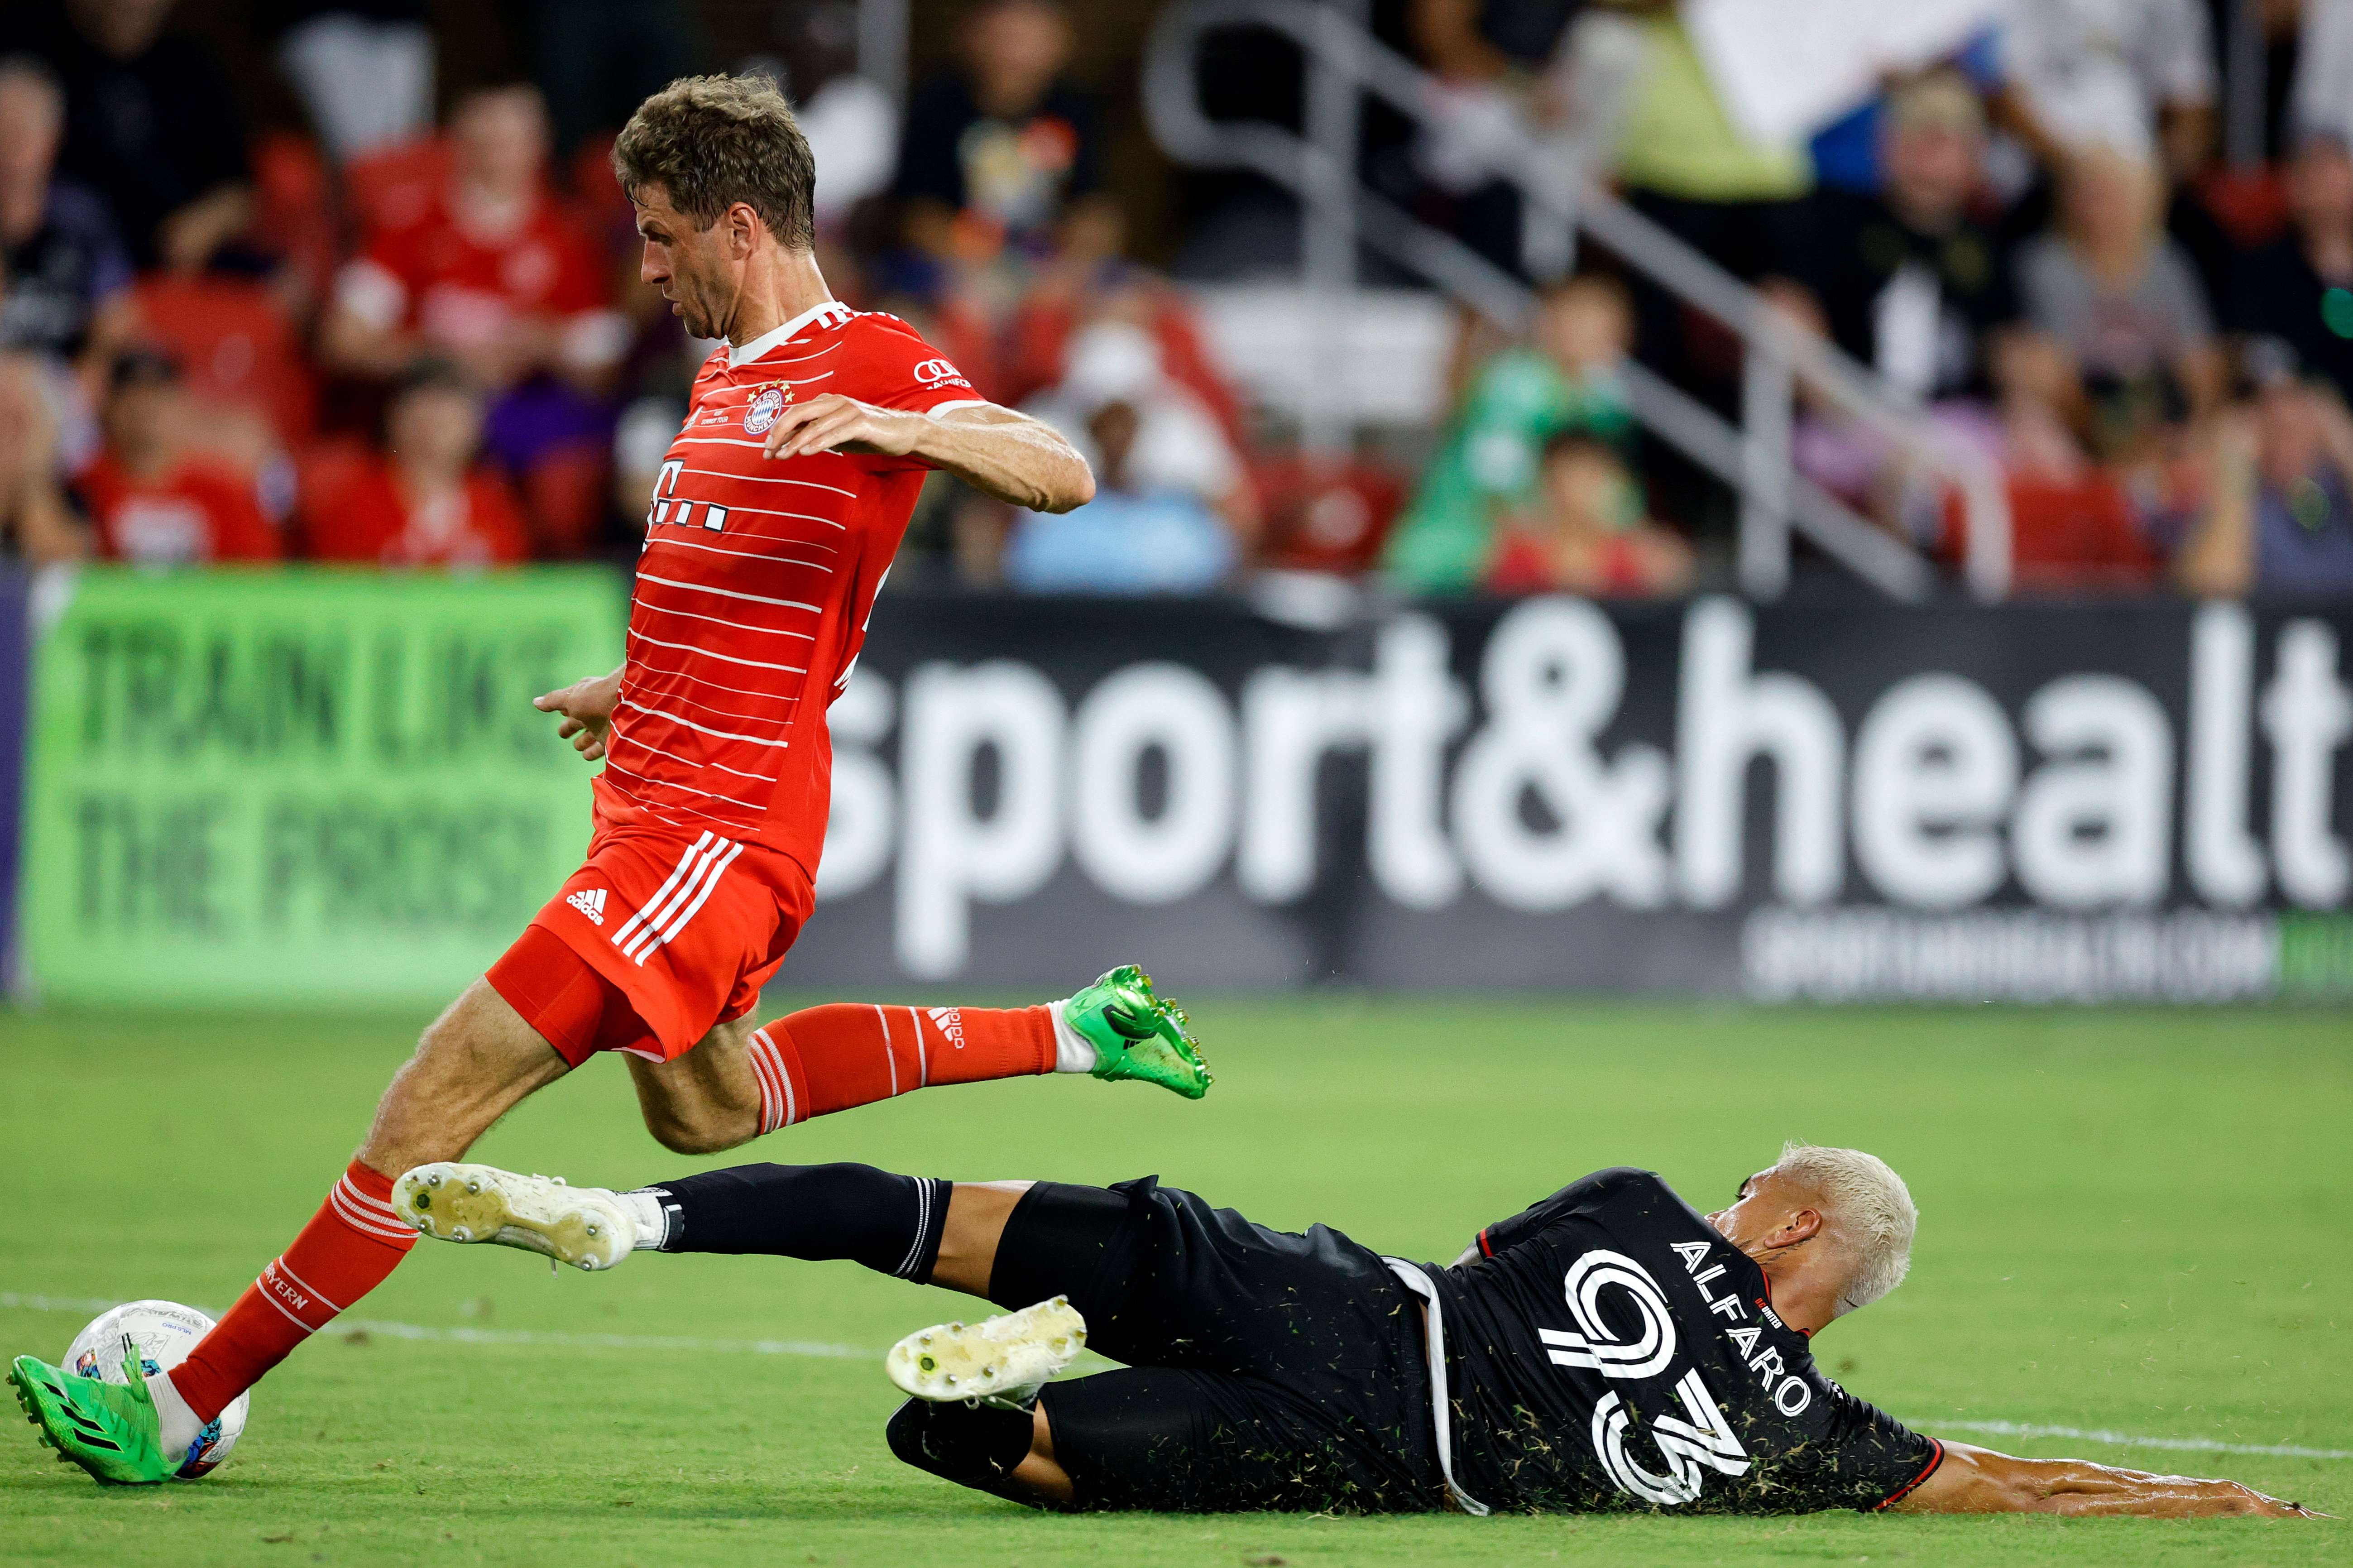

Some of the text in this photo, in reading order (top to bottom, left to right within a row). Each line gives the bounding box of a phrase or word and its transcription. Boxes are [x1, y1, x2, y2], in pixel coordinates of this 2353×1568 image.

[763, 392, 780, 410] BAYERN
[81, 623, 564, 765] TRAIN LIKE
[75, 795, 225, 935] THE
[566, 894, 604, 926] adidas
[162, 1322, 192, 1335] MLS PRO
[264, 1261, 309, 1310] BAYERN
[1670, 1241, 1811, 1417] ALFARO
[1538, 1248, 1752, 1506] 93
